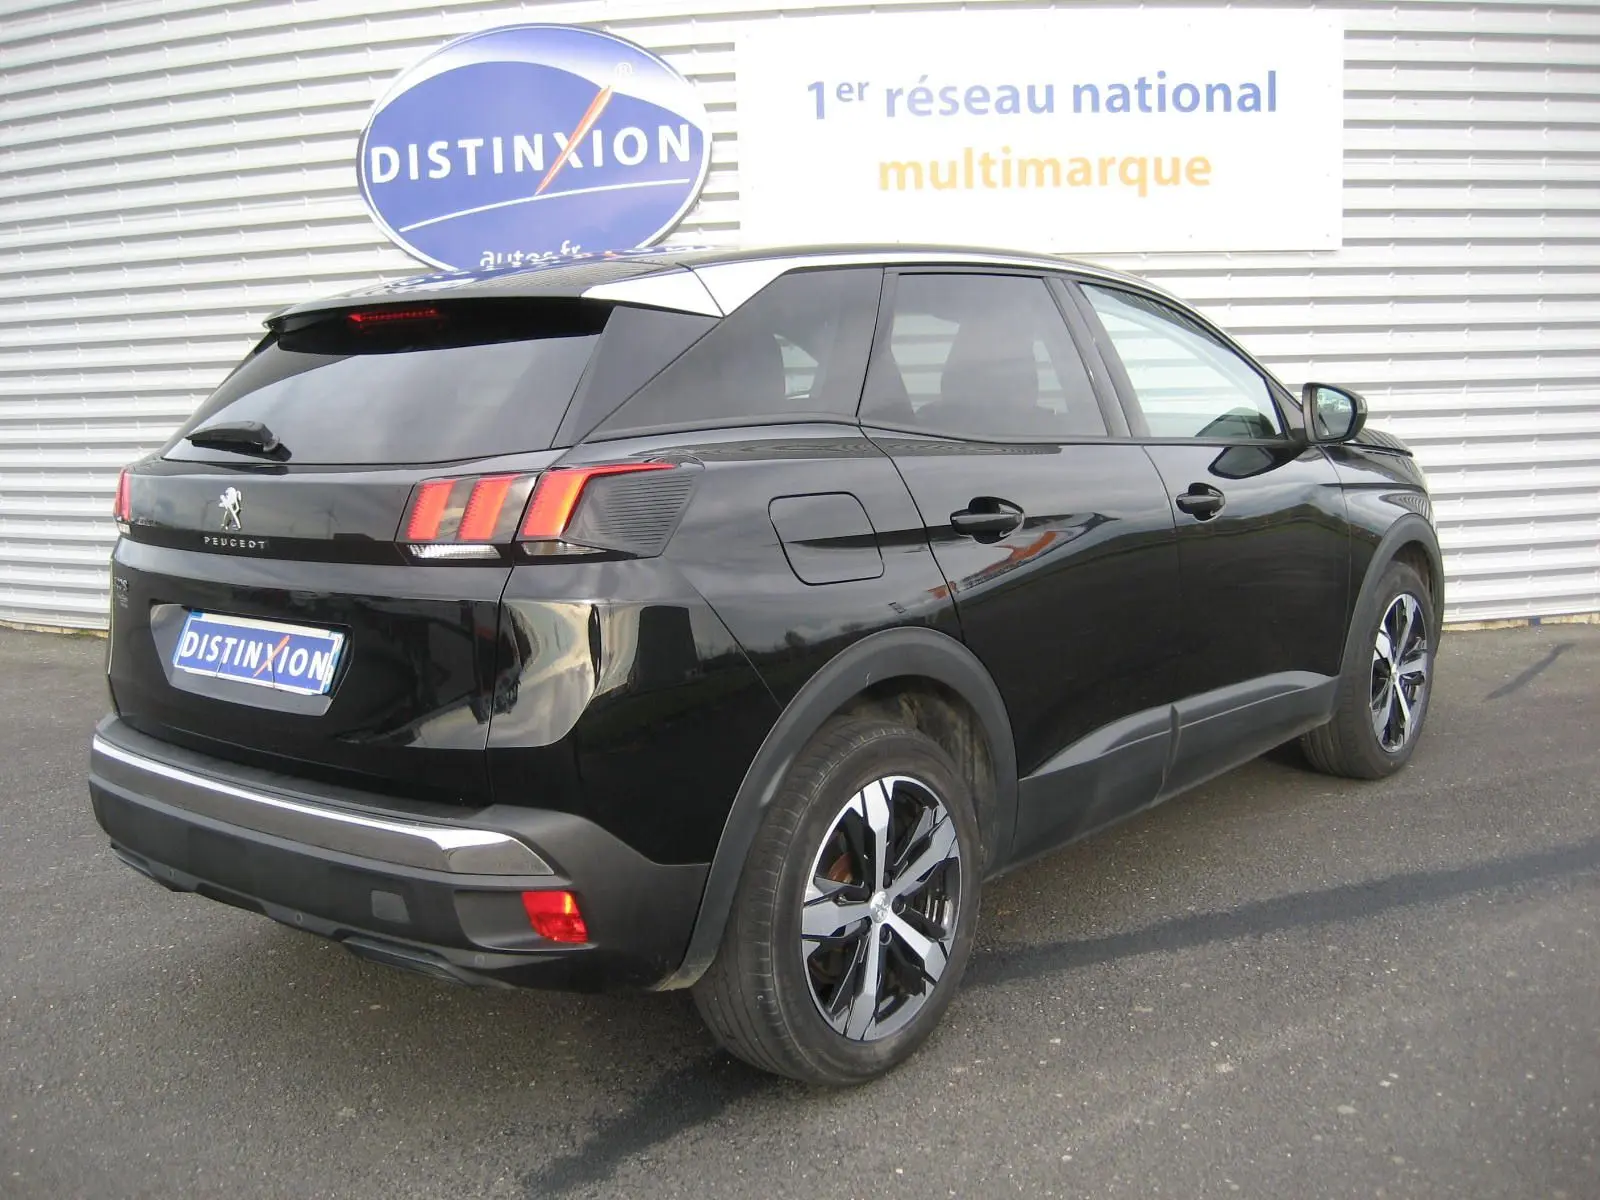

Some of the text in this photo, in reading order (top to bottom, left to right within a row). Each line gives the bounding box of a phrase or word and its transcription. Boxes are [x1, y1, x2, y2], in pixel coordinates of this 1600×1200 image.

[807, 70, 1278, 120] 1er réseau national
[370, 85, 690, 195] DISTINXION
[879, 146, 1212, 198] multimarque
[203, 536, 265, 549] PEUGEOT
[180, 631, 329, 681] DISTINXION
